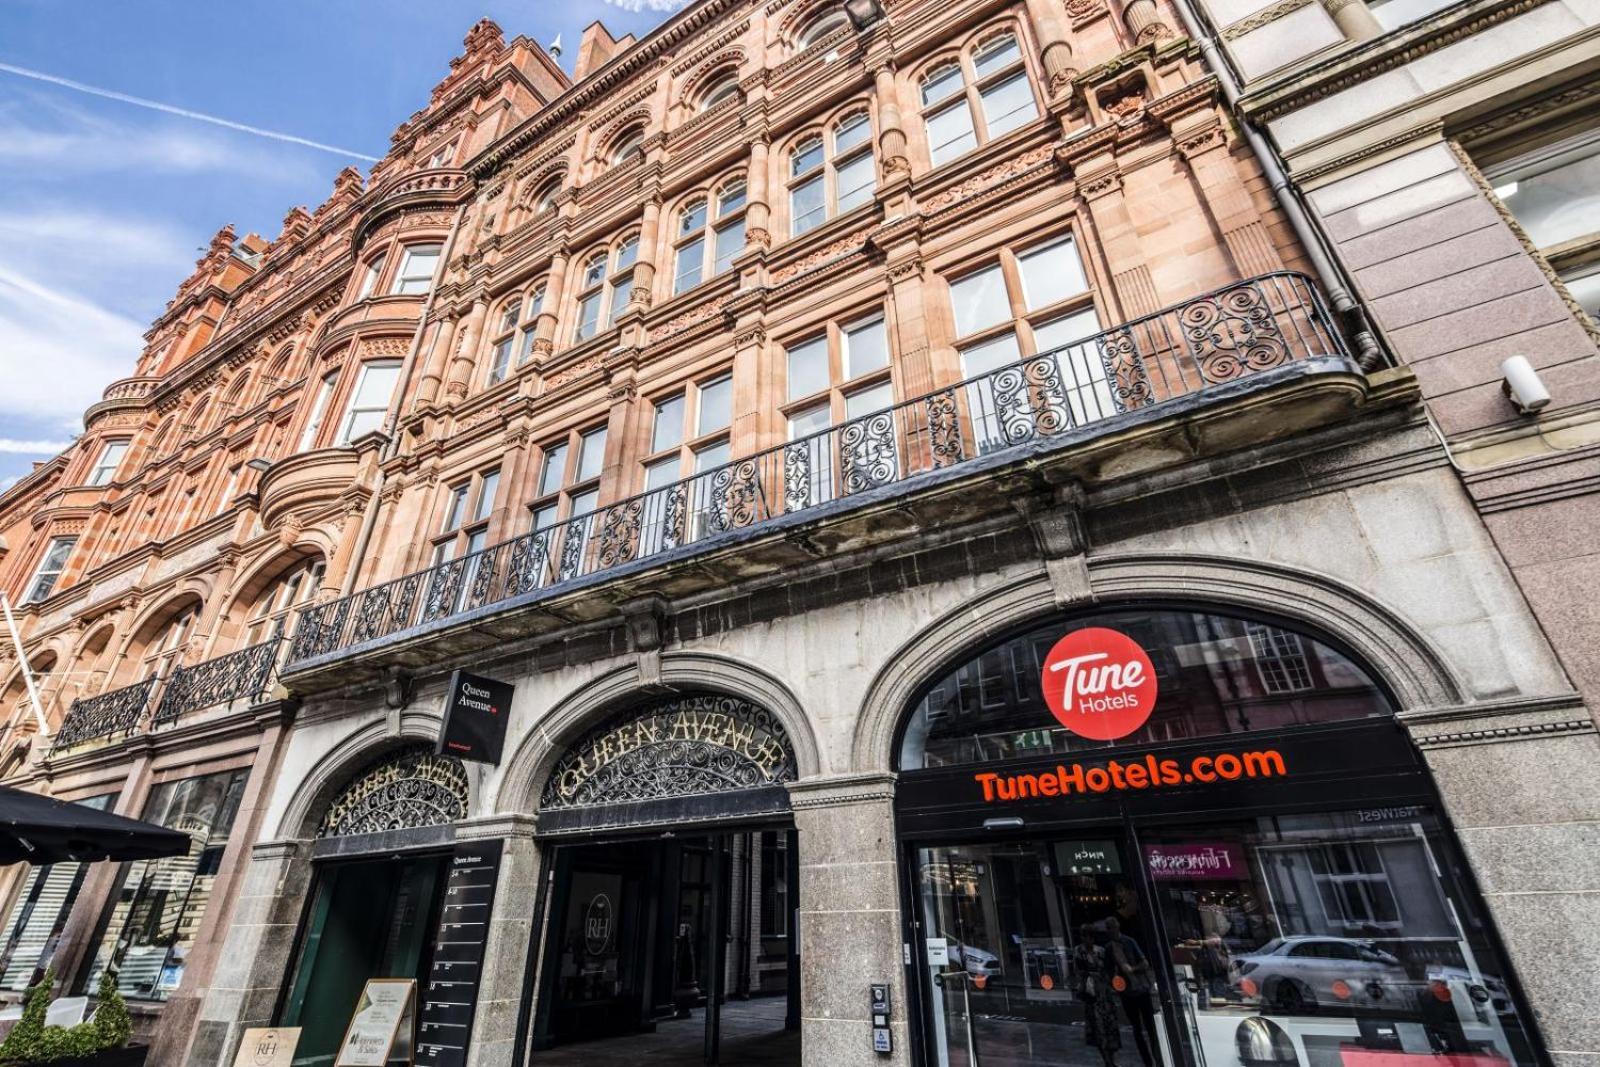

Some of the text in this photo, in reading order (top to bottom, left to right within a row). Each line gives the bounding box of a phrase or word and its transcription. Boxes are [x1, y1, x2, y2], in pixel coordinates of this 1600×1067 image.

[462, 682, 490, 699] Queen
[1050, 653, 1146, 711] Tune
[1079, 692, 1138, 714] Hotels
[560, 711, 786, 796] QUEEN AVENUE
[974, 750, 1287, 802] TuneHotels.com
[586, 917, 609, 938] RH
[256, 1042, 277, 1055] RH
